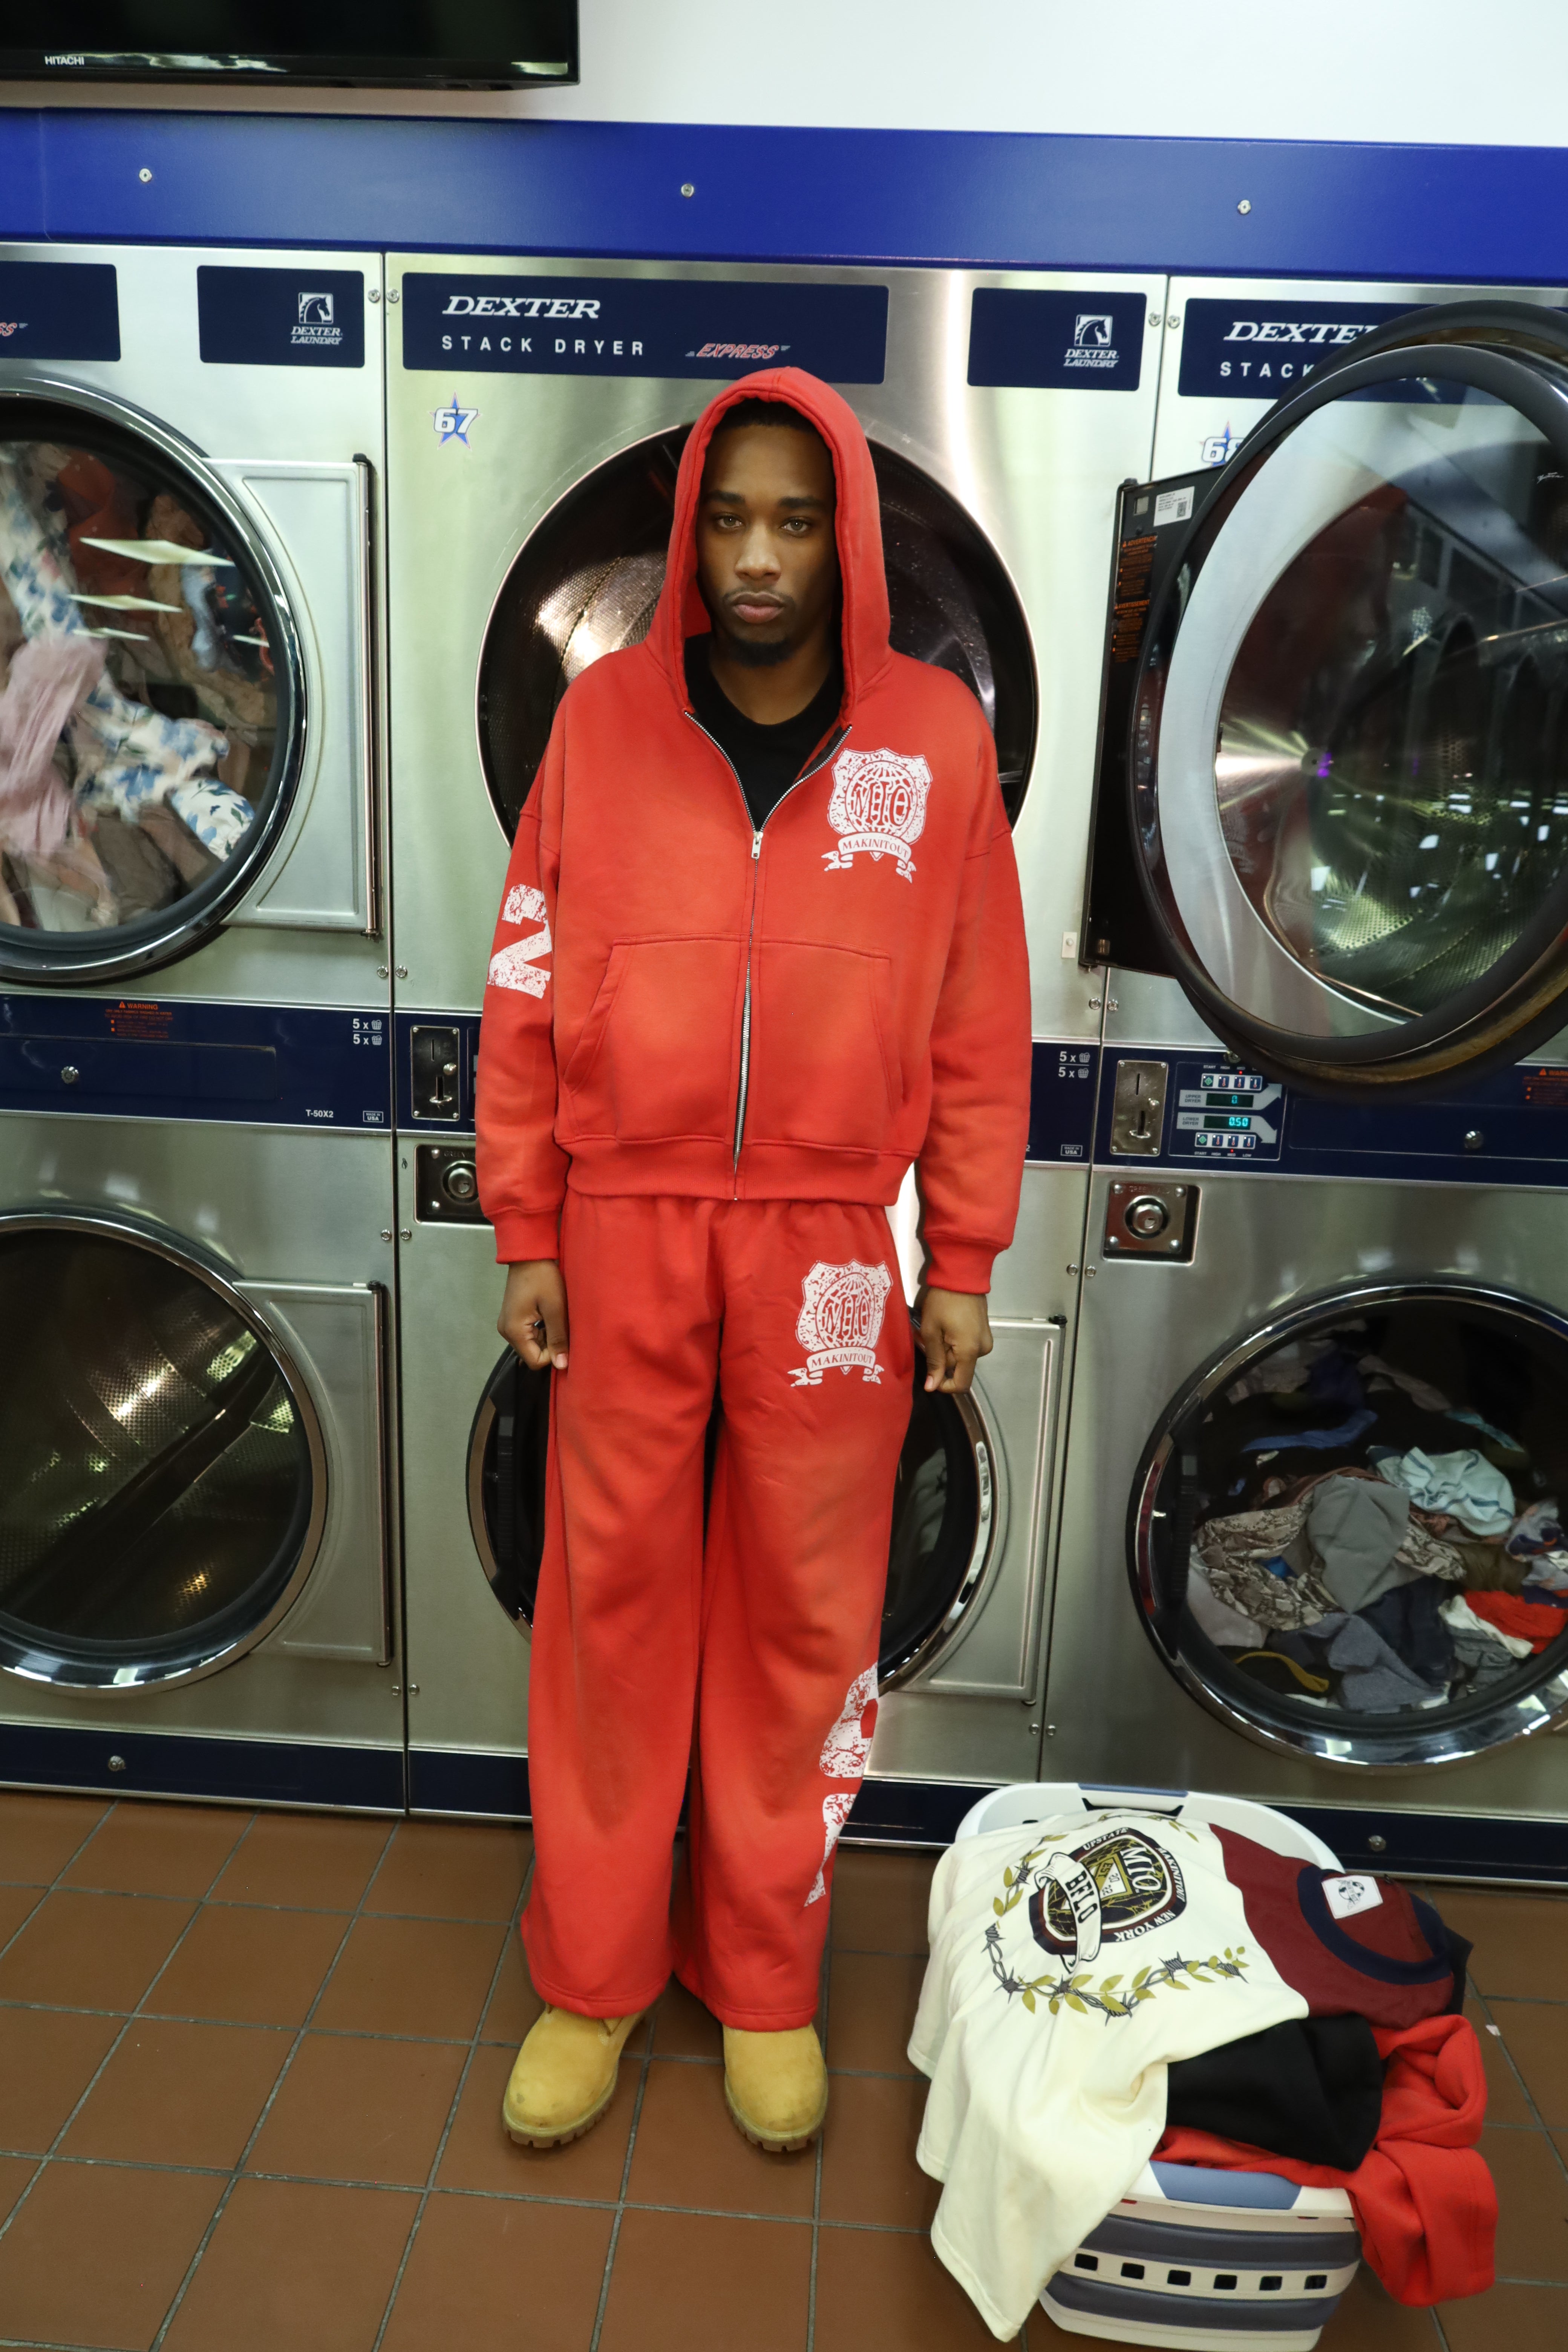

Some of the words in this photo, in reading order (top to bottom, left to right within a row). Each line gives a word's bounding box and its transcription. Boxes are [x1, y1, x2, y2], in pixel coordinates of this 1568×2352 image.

[44, 56, 85, 65] HITACHI
[442, 296, 600, 319] DEXTER
[291, 326, 341, 336] DEXTER
[290, 335, 343, 345] LAUNDRY
[442, 335, 532, 352] STACK
[555, 338, 643, 355] DRYER
[696, 343, 779, 359] EXPRESS
[1064, 348, 1117, 359] DEXTER
[1063, 358, 1119, 368] LAUNDRY
[432, 408, 478, 434] 67
[842, 838, 909, 858] MAKINITOUT
[352, 1018, 360, 1029] 5
[353, 1034, 360, 1044] 5
[1059, 1051, 1067, 1062] 5
[1058, 1067, 1066, 1077] 5
[306, 1109, 334, 1118] T-50X2
[1229, 1117, 1248, 1127] 0.50
[811, 1353, 873, 1368] MAKINITOUT
[1083, 1828, 1129, 1851] UPSTATE
[1119, 1847, 1162, 1891] MIO
[1155, 1847, 1186, 1902] MAKINITOUT
[1154, 1909, 1176, 1925] NEW
[1113, 1922, 1155, 1942] YORK
